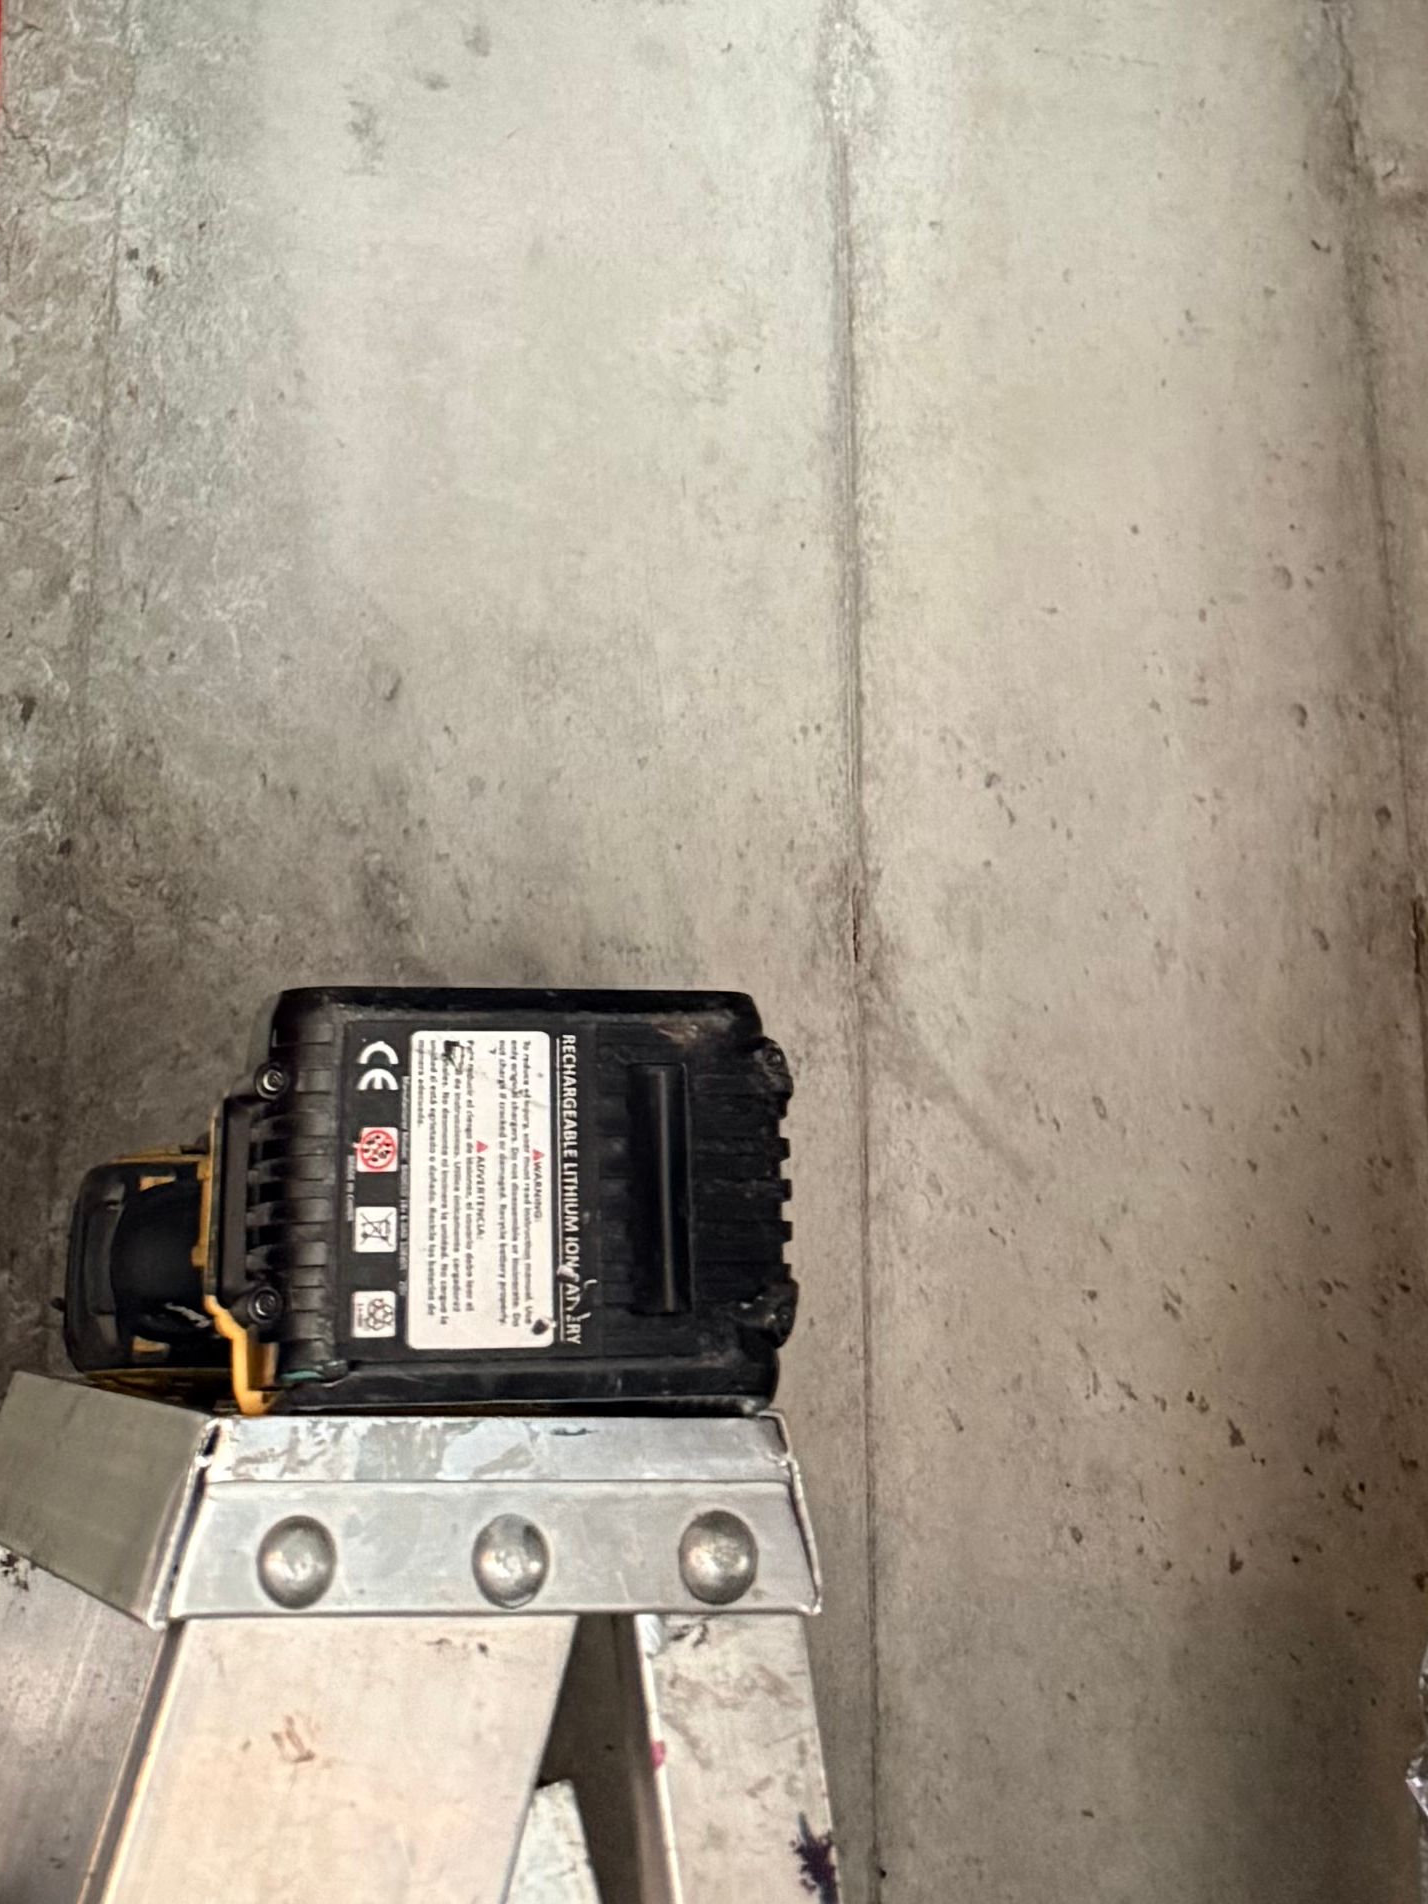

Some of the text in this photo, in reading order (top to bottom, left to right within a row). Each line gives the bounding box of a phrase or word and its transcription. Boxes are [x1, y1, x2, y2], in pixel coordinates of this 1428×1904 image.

[522, 1053, 530, 1085] reduce
[465, 1142, 473, 1153] de
[509, 1162, 519, 1179] not
[523, 1182, 531, 1204] read
[533, 1161, 542, 1222] WARNING:
[561, 1034, 581, 1344] RECHARGEABLE LITHIUM ION ATERY
